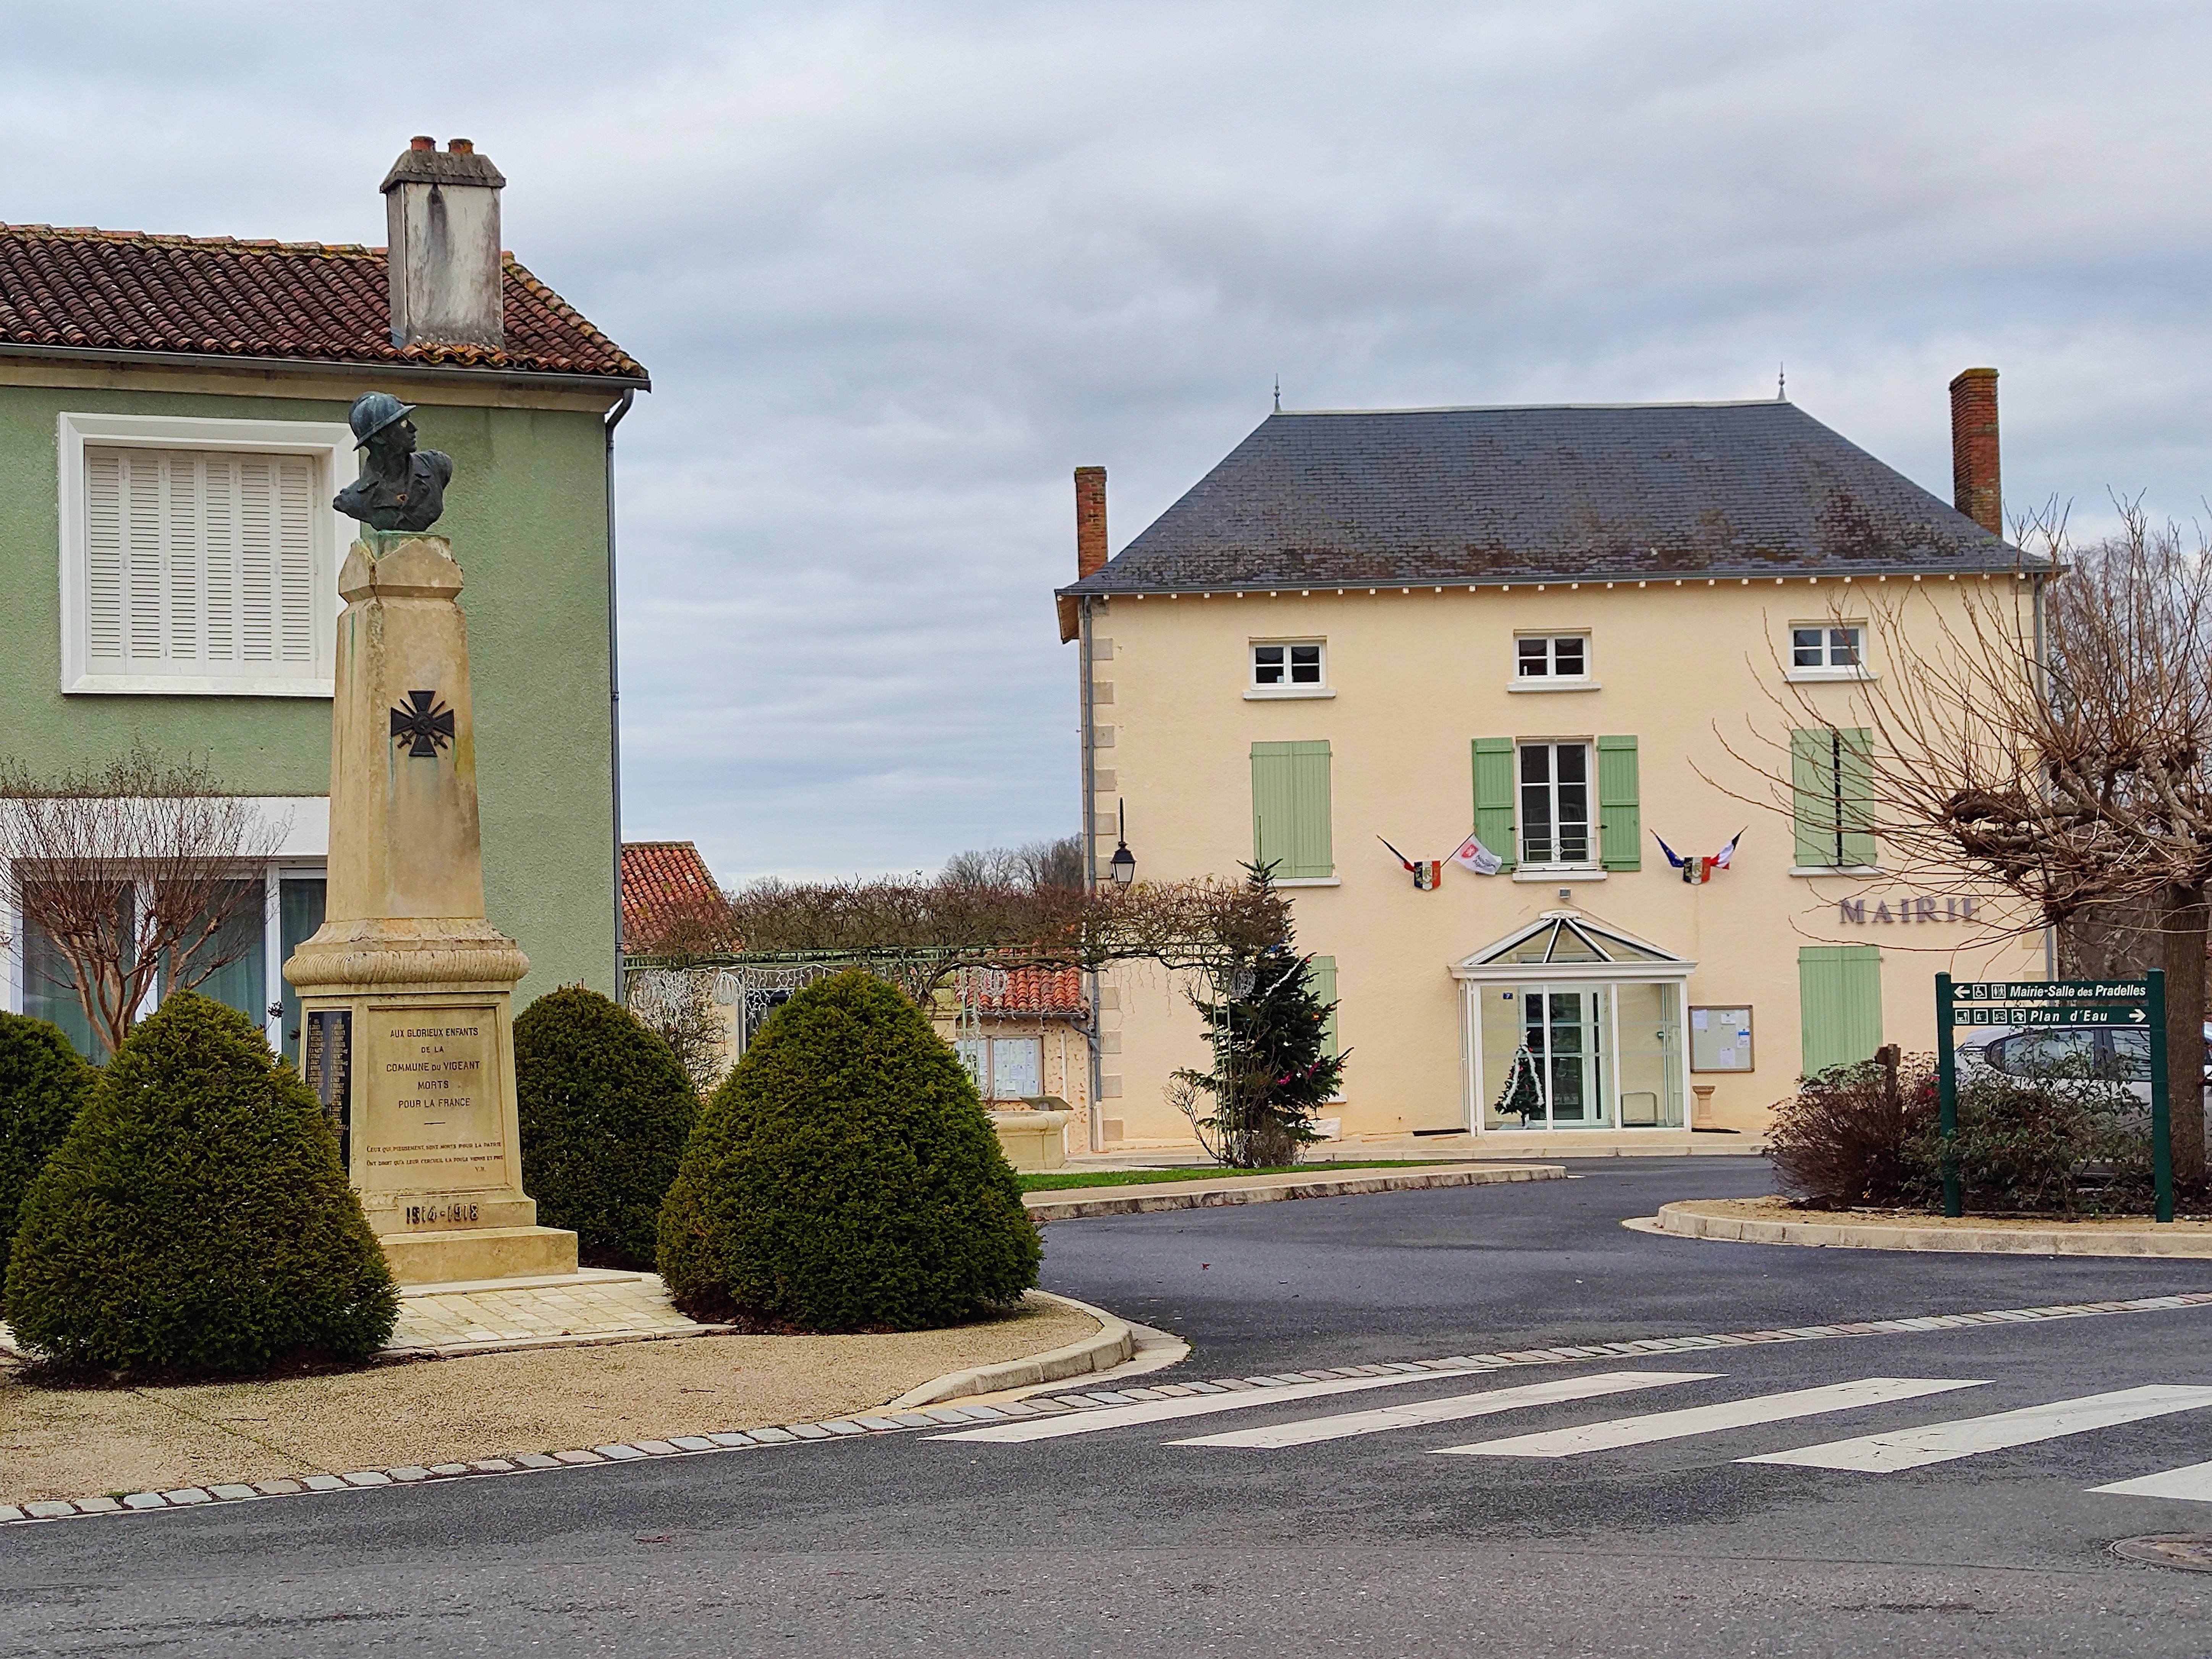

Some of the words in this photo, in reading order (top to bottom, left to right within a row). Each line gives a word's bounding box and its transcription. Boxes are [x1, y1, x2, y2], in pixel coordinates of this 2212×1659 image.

[1840, 897, 1981, 923] MAIRIE
[2010, 985, 2075, 997] Mairie-Salle
[2077, 987, 2093, 996] des
[2095, 984, 2146, 996] Pradelles
[2030, 1010, 2060, 1022] Plan
[2070, 1010, 2108, 1022] d'Eau
[390, 1030, 404, 1038] AUX
[407, 1028, 443, 1037] GLORIEUX
[446, 1027, 479, 1036] ENFANTS
[386, 1062, 429, 1072] COMMUNE
[443, 1061, 480, 1070] VIGEANT
[418, 1080, 449, 1090] MORTS
[399, 1100, 421, 1108] POUR
[424, 1099, 435, 1108] LA
[438, 1098, 471, 1107] FRANCE
[406, 1202, 478, 1224] 1914-1918
